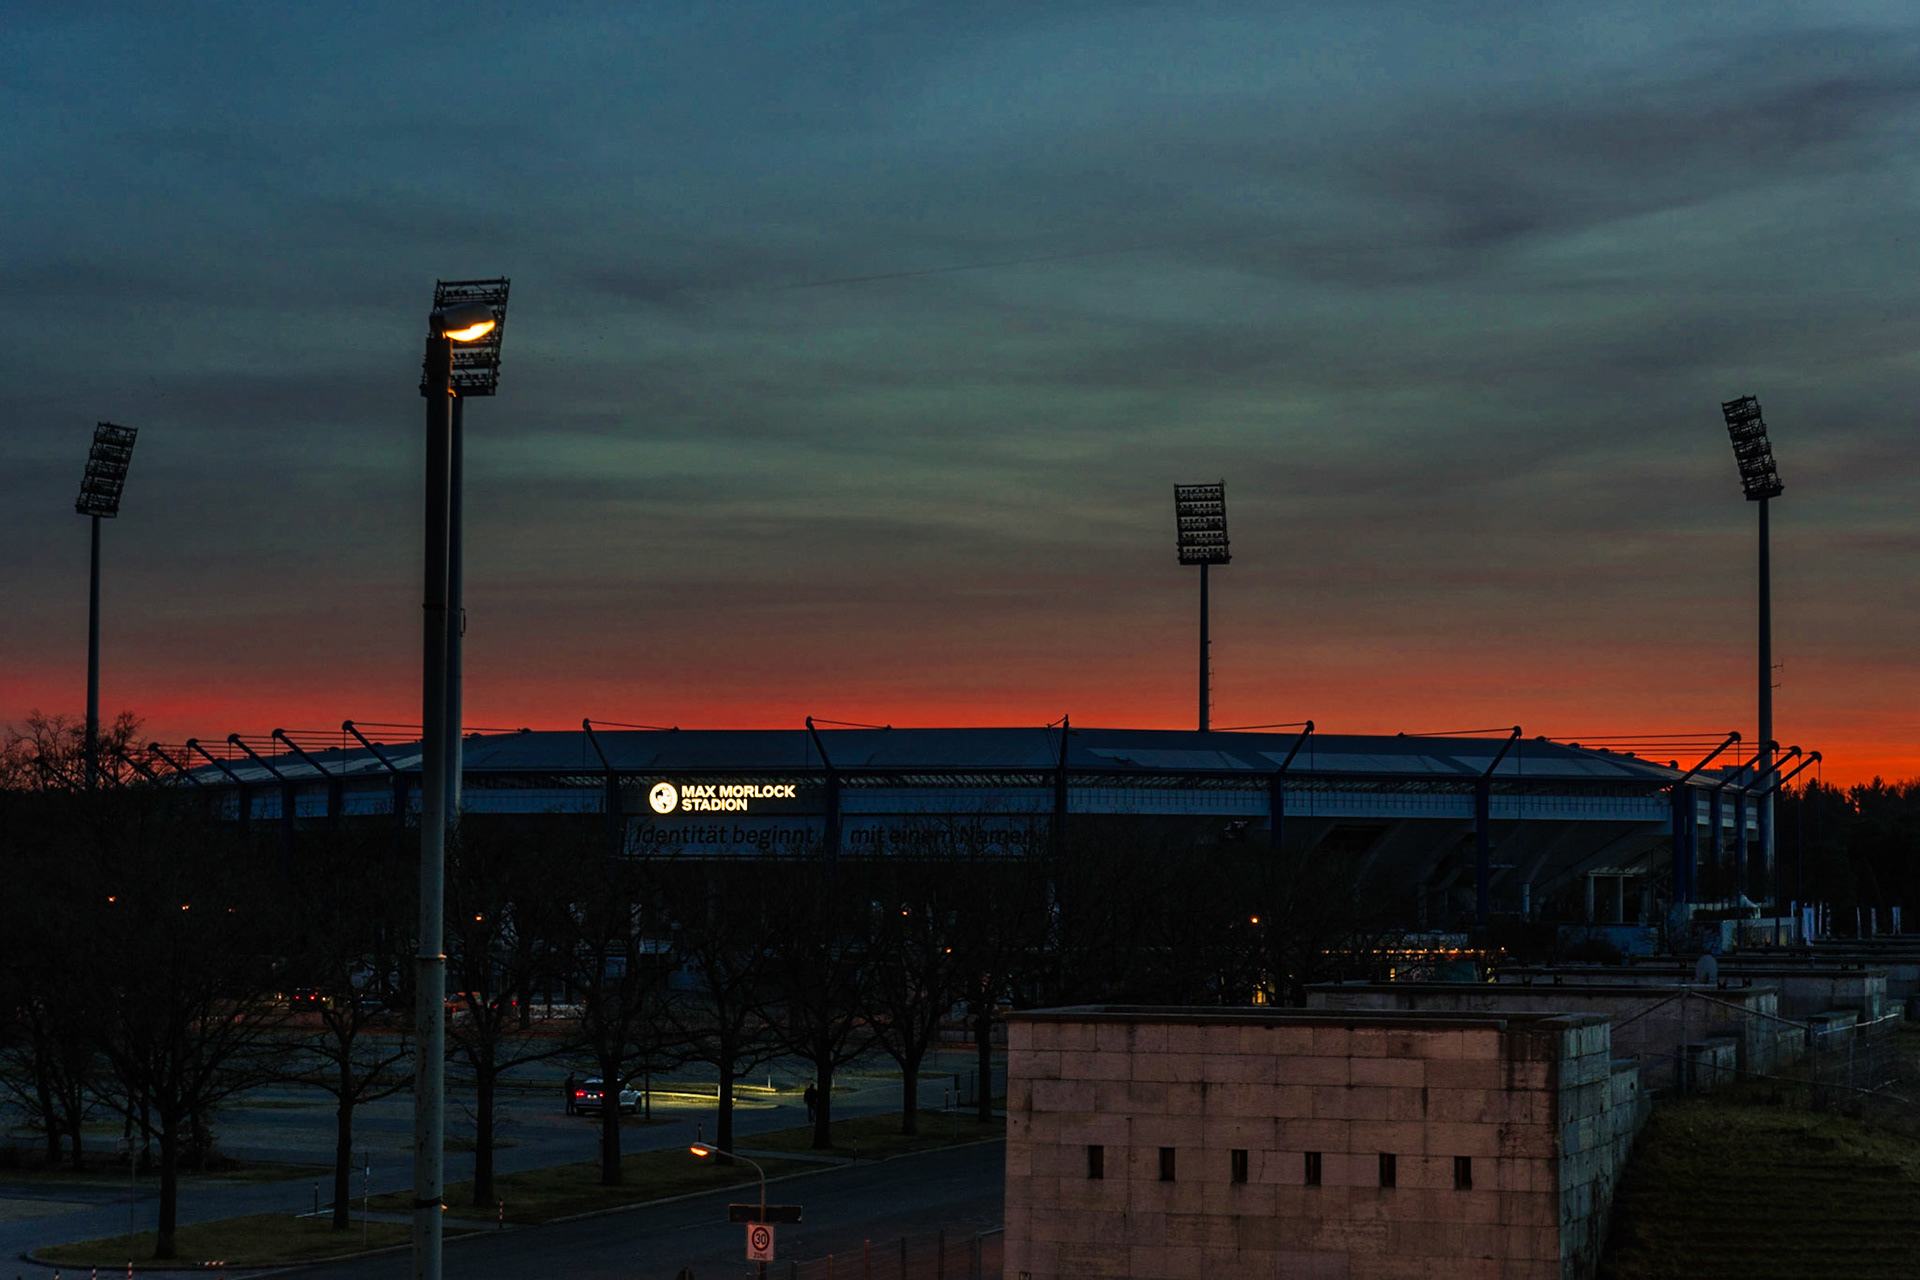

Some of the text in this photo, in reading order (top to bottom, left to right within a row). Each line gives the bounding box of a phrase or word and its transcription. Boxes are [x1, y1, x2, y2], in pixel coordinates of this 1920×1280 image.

[681, 785, 796, 798] MAX MORLOCK
[681, 799, 748, 811] STADION
[636, 824, 815, 849] Identität beginnt
[850, 824, 885, 844] mit
[756, 1233, 766, 1245] 30
